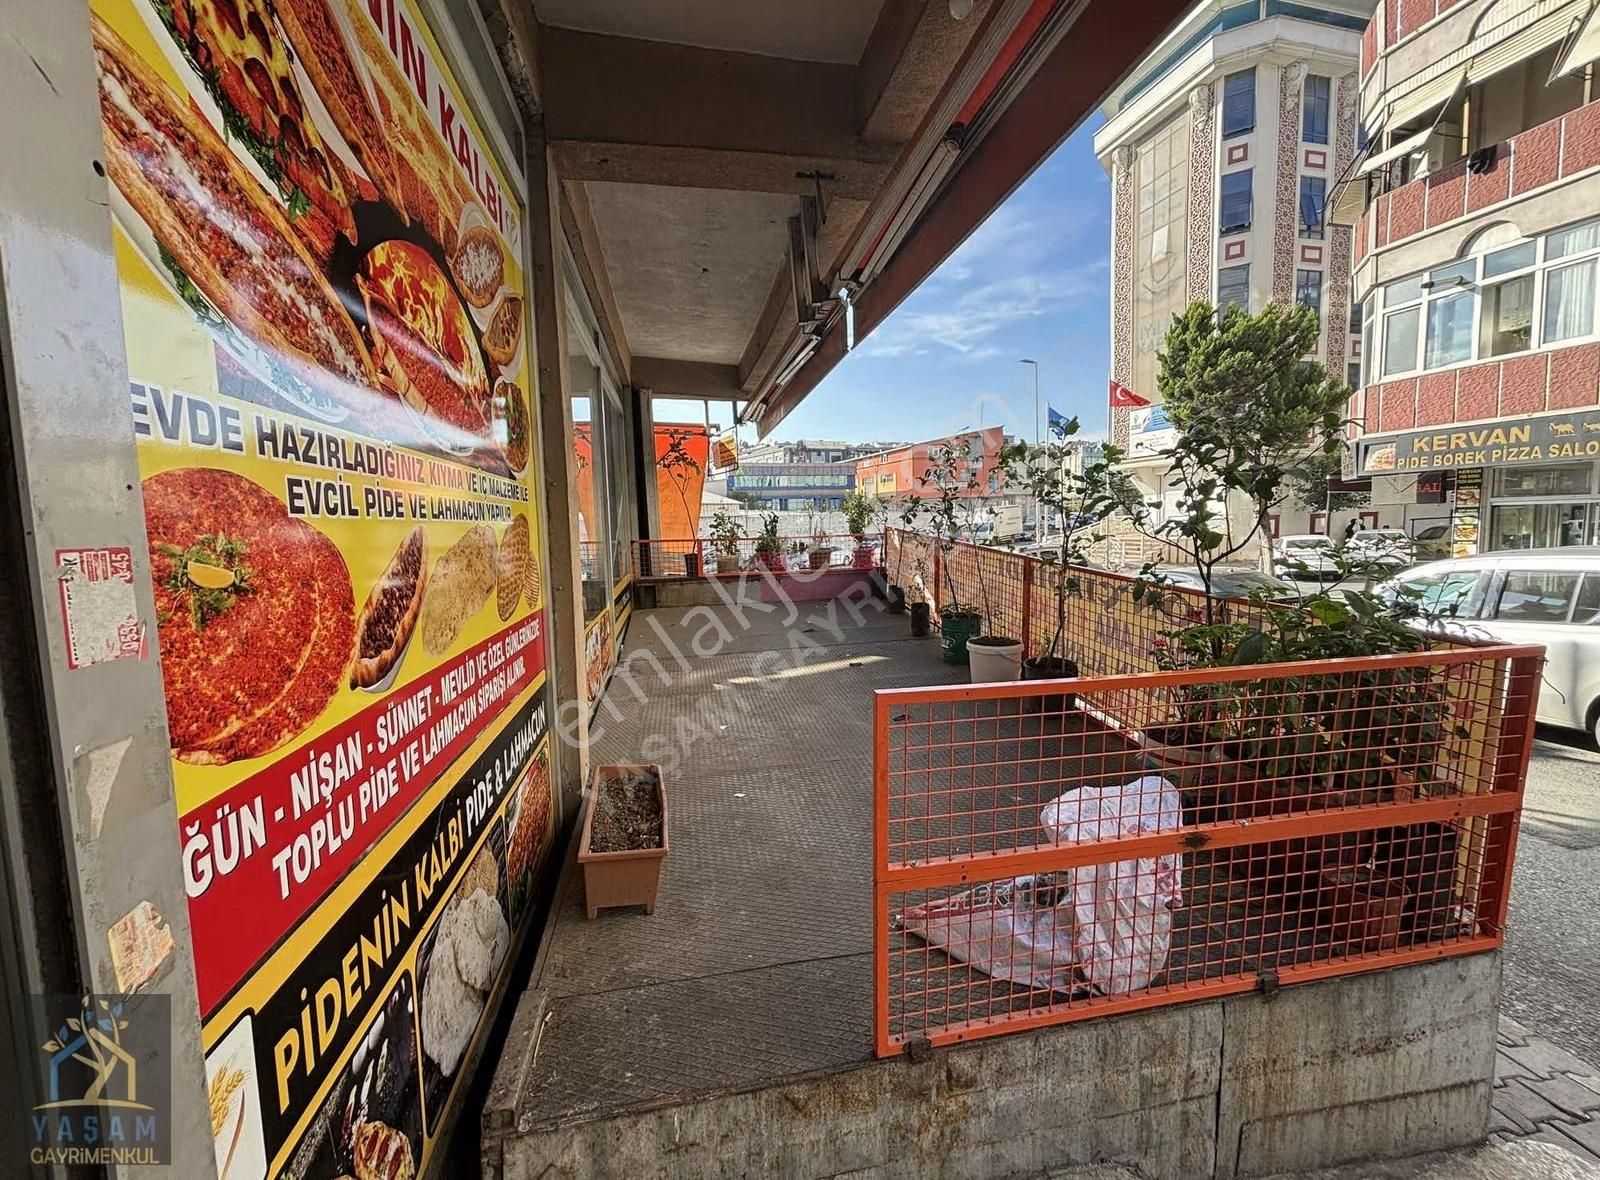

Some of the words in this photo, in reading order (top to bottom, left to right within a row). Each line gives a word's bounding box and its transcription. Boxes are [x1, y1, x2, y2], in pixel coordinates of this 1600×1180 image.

[438, 83, 503, 233] KALBİ
[130, 382, 243, 452] EVDE
[255, 415, 425, 483] HAZIRLADIĞINIZ
[428, 461, 464, 491] KIYMA
[466, 471, 477, 493] VE
[488, 477, 519, 500] MALZEME
[286, 475, 359, 517] EVCİL
[364, 479, 405, 518] PİDE
[410, 493, 427, 519] VE
[431, 496, 485, 521] LAHMACUN
[1412, 425, 1531, 453] KERVAN
[1433, 450, 1486, 467] BÖREK
[1491, 445, 1542, 462] PİZZA
[182, 795, 267, 898] ĞÜN
[290, 731, 363, 820] NİŞAN
[376, 685, 433, 754] SÜNNET
[440, 655, 476, 706] MEVLİD
[476, 651, 488, 679] VE
[487, 641, 505, 671] ÖZEL
[272, 794, 355, 901] TOPLU
[358, 758, 399, 825] PİDE
[400, 739, 421, 781] VE
[421, 694, 478, 766] LAHMACUN
[477, 663, 507, 715] SİPARİŞİ
[273, 883, 411, 1115] PİDENİN
[414, 800, 464, 909] KALBİ
[465, 768, 494, 838] PİDE
[494, 757, 504, 795] &
